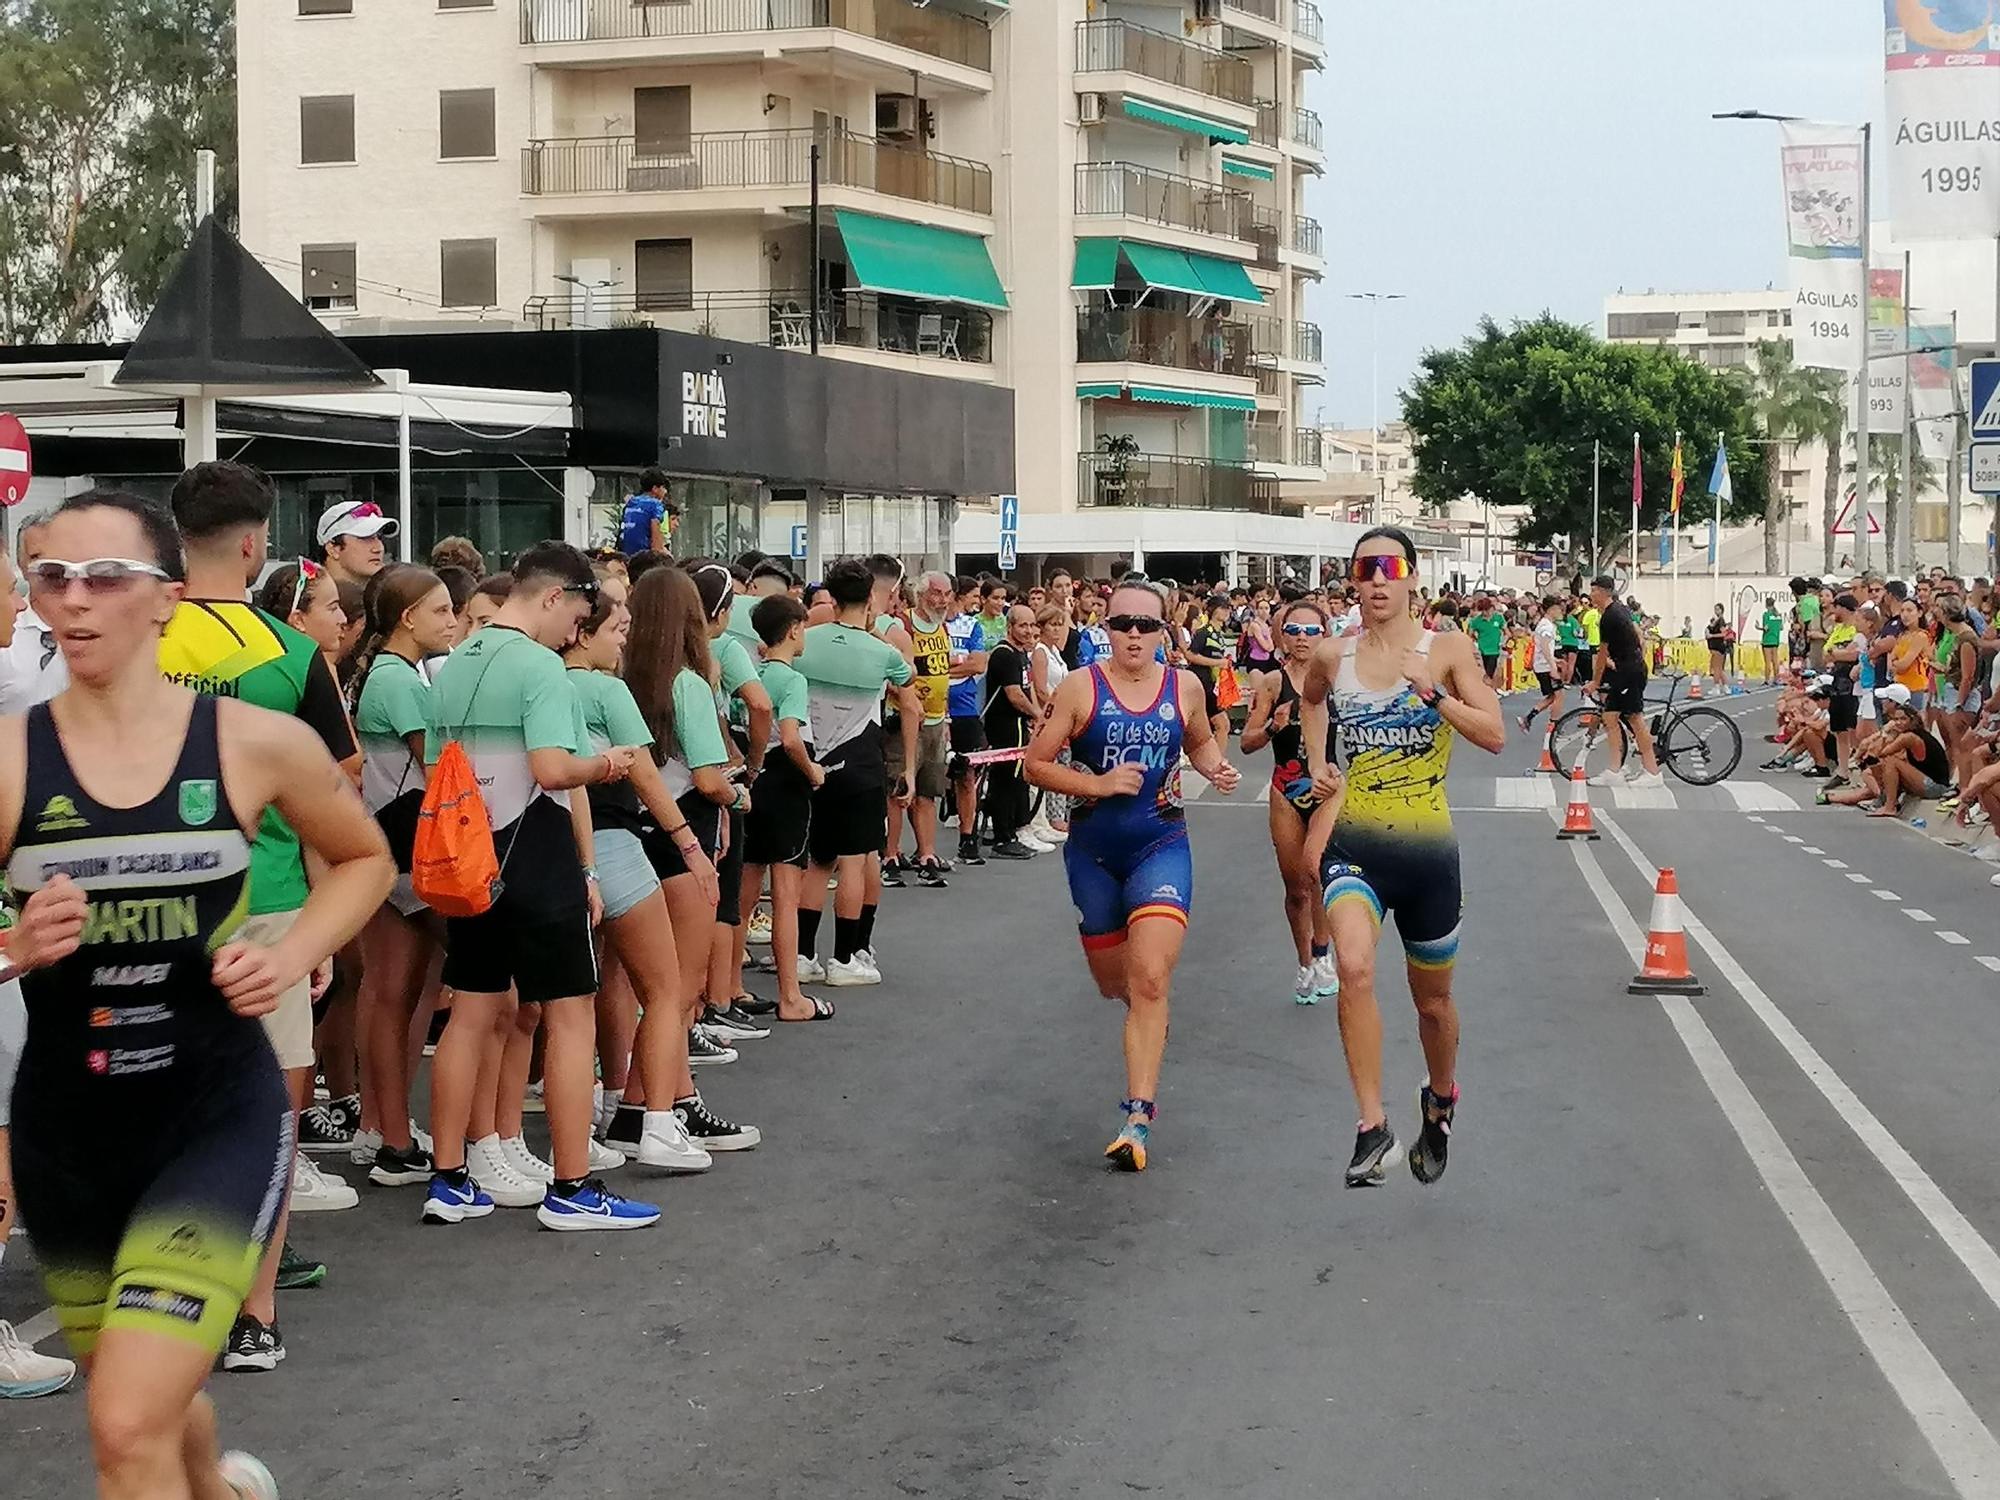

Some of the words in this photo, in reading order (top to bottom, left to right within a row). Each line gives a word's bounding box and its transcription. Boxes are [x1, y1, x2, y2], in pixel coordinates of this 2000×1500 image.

[1921, 166, 1981, 193] 1995
[1796, 287, 1858, 309] ÁGUILAS
[1809, 321, 1850, 338] 1994
[1870, 398, 1894, 412] 993
[1106, 720, 1124, 744] Gil
[1125, 721, 1142, 743] de
[1144, 720, 1171, 744] Sola
[1102, 744, 1169, 769] RCM
